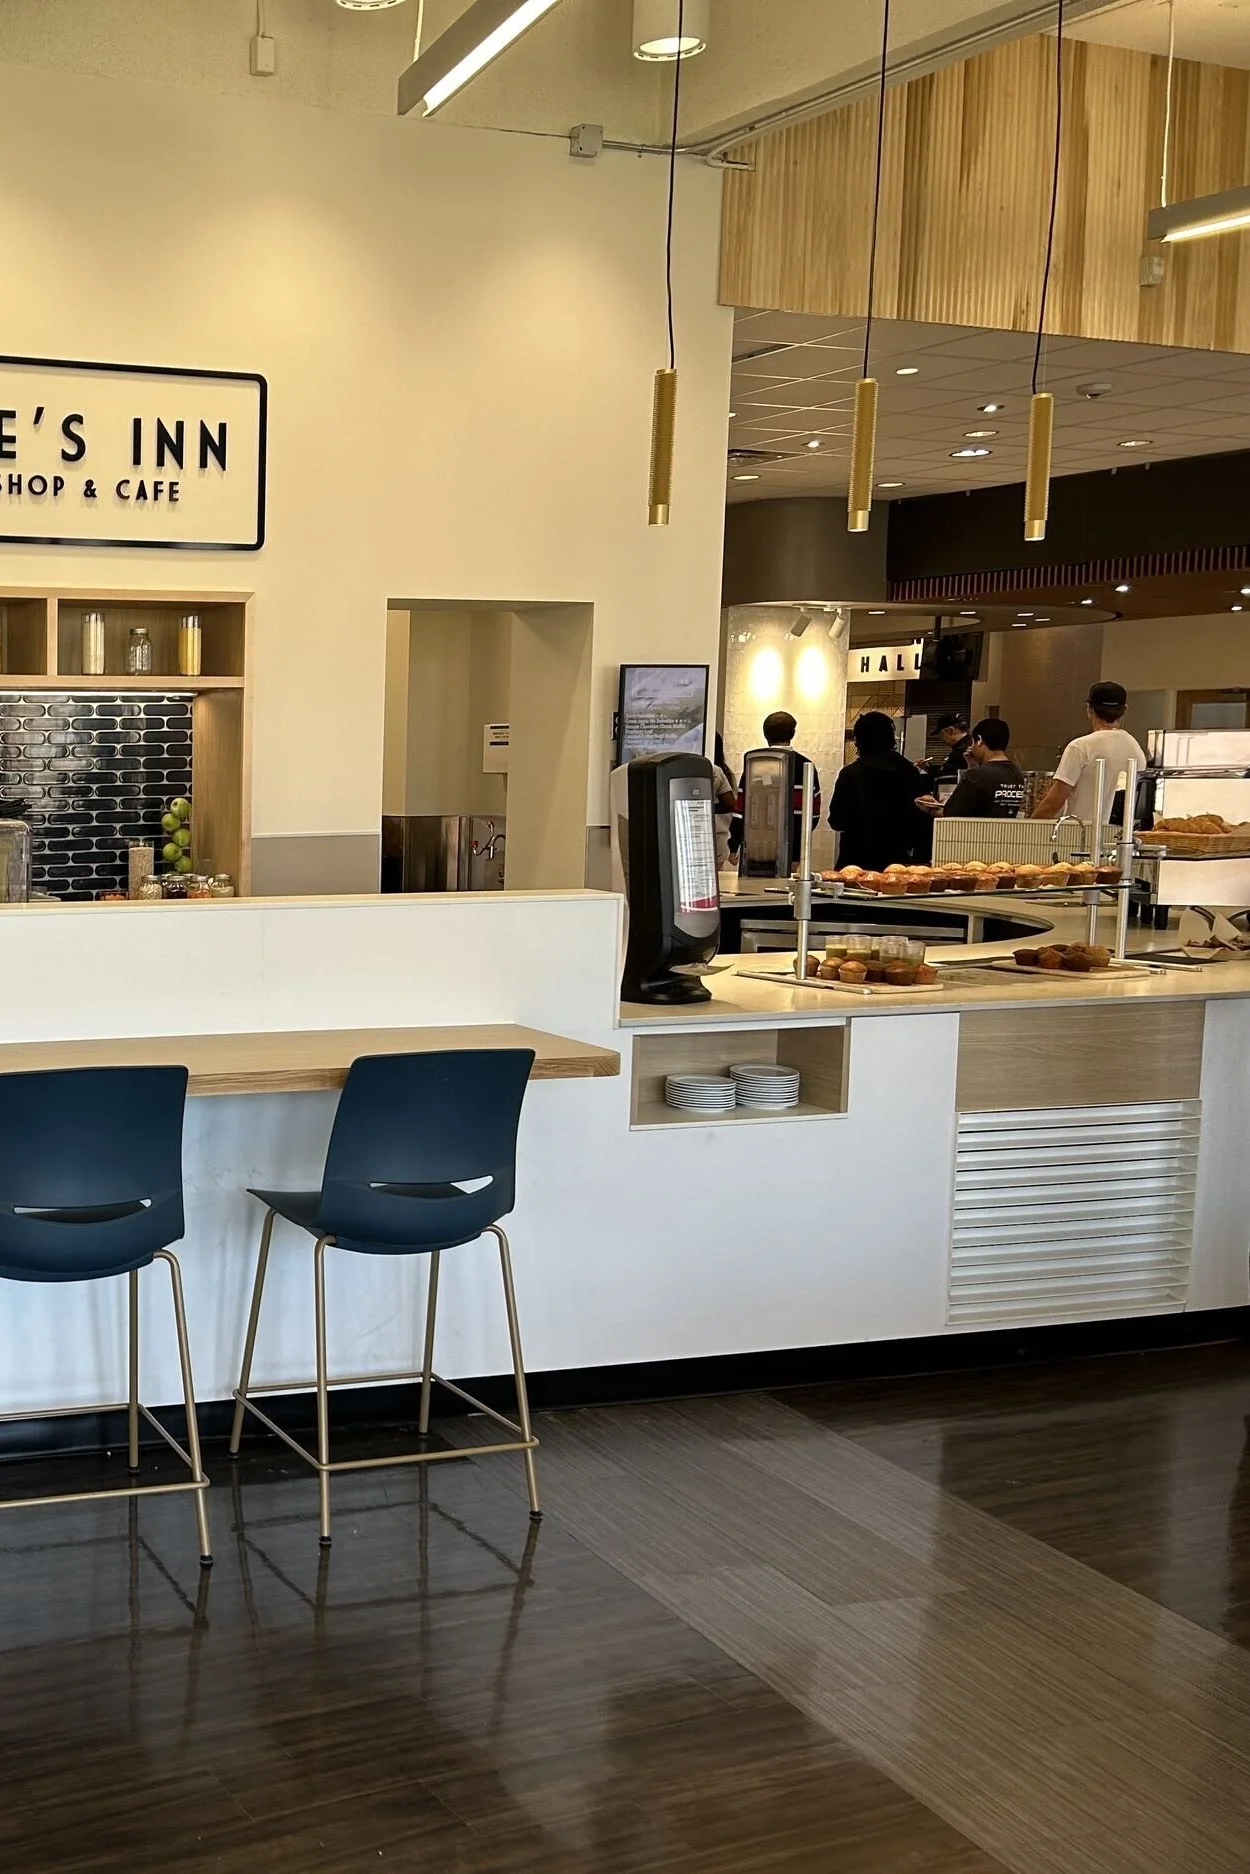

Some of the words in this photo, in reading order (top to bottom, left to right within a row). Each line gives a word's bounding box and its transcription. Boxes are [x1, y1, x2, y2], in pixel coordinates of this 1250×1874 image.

[132, 417, 228, 471] INN
[83, 480, 98, 498] &
[116, 479, 180, 502] CAFE
[861, 653, 921, 672] HALL
